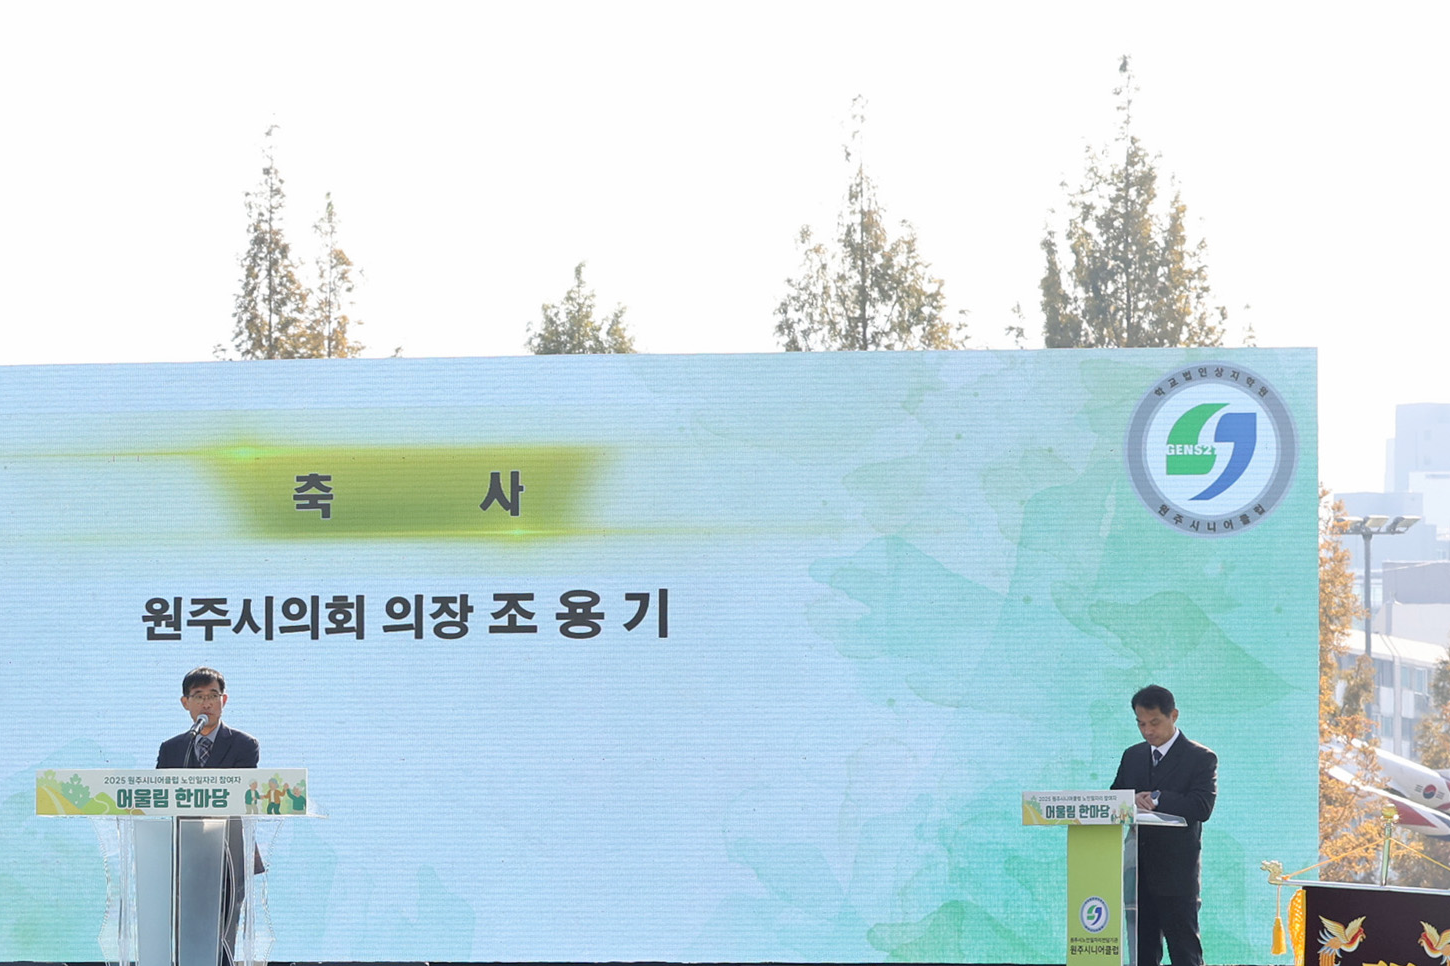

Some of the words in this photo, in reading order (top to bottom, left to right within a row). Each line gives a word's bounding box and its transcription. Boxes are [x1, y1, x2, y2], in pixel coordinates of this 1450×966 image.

[1154, 367, 1269, 398] 학교법인상지학원
[292, 472, 334, 520] 축
[479, 470, 525, 517] 사
[142, 594, 366, 641] 원주시의회
[382, 593, 475, 640] 의장
[104, 776, 126, 785] 2025
[128, 776, 179, 785] 원주시니어클럽
[181, 776, 218, 785] 노인일자리
[219, 775, 242, 784] 참여자
[117, 788, 169, 808] 어울림
[175, 787, 230, 808] 한마당
[1045, 805, 1075, 819] 어울림
[1079, 804, 1110, 819] 한마당
[1070, 945, 1119, 955] 원주시니어클럽
